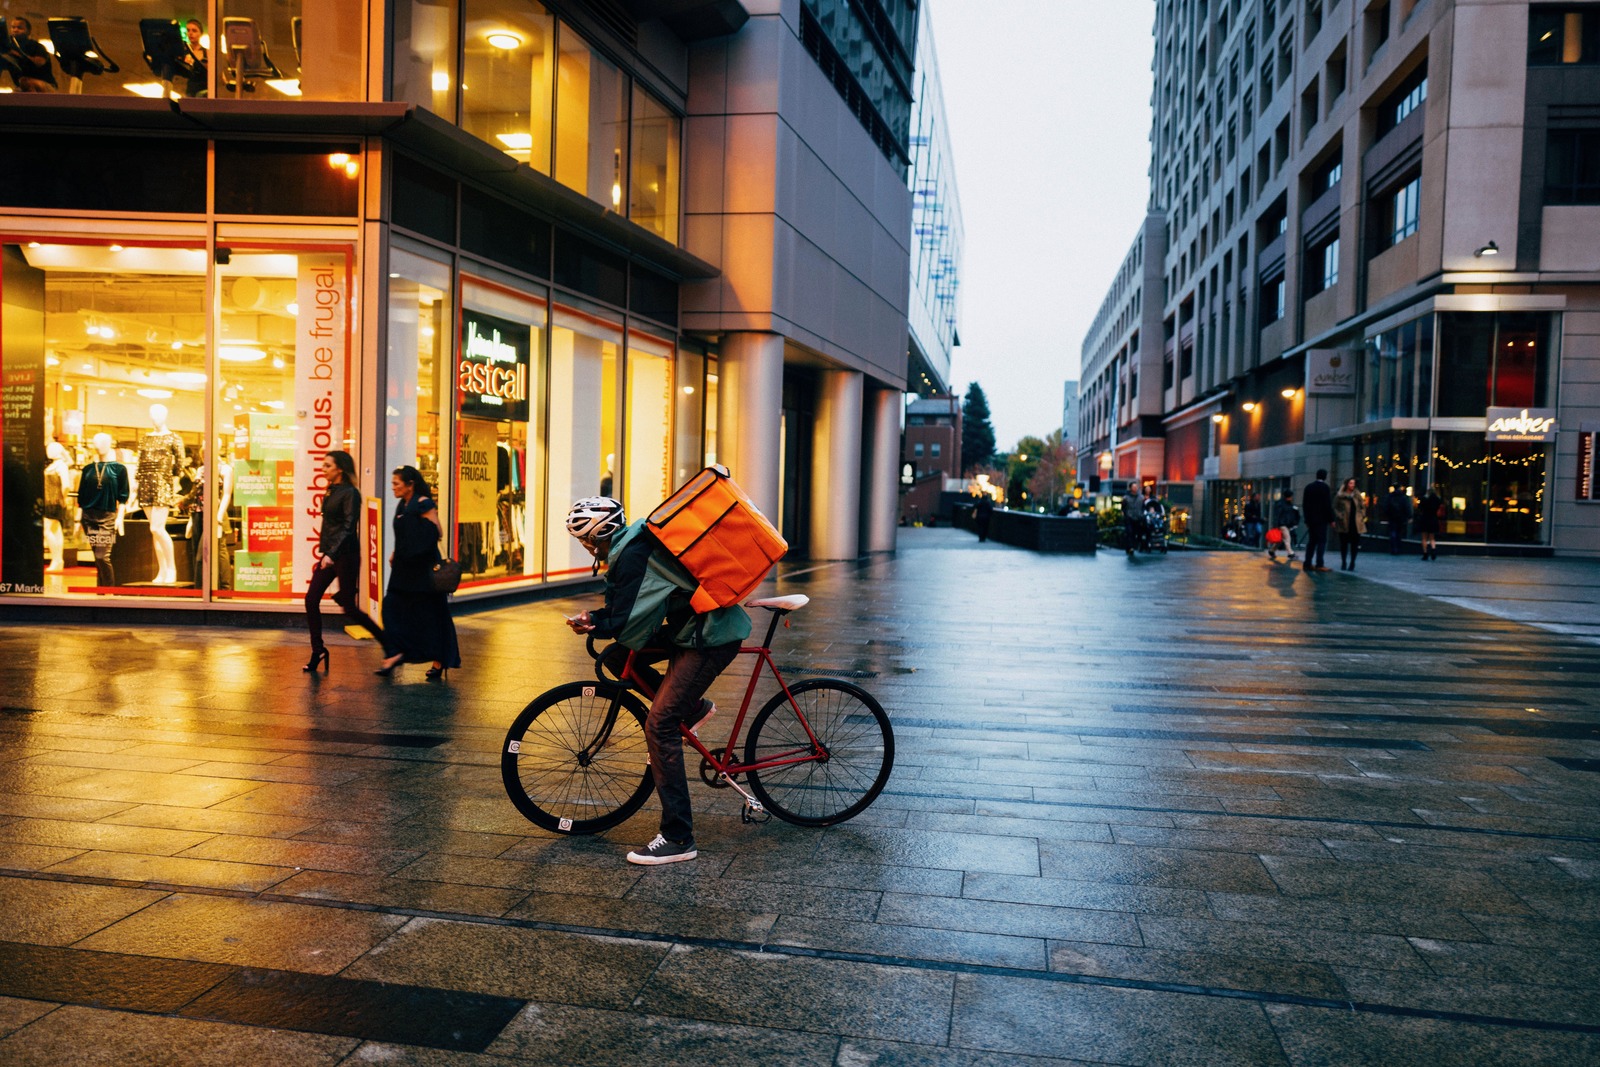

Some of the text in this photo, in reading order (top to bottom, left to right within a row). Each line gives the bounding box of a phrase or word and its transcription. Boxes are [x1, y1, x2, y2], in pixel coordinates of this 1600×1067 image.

[309, 262, 340, 339] frugal.
[308, 347, 333, 380] be
[459, 358, 527, 400] astcall
[1488, 408, 1555, 435] amber
[461, 467, 491, 481] FRUGAL.
[250, 528, 294, 536] PRESENTS
[252, 521, 291, 529] PERFECT
[370, 523, 378, 586] SALE
[236, 574, 277, 582] PRESENTS
[239, 567, 275, 575] PERFECT
